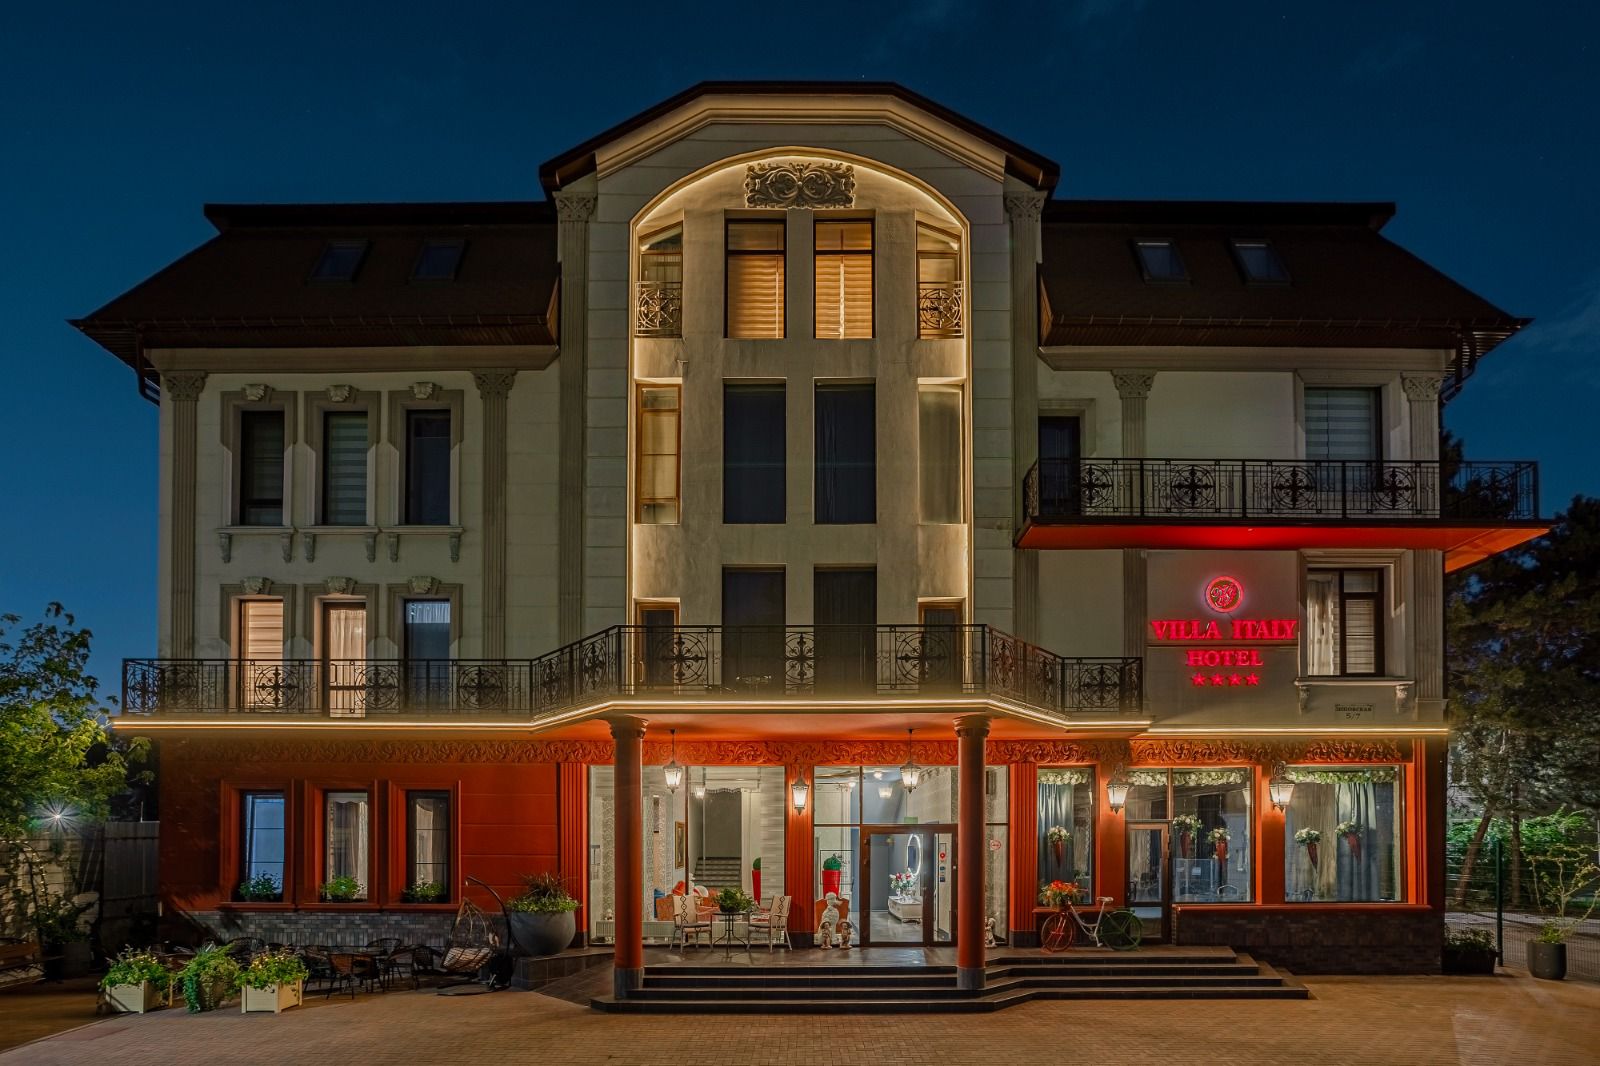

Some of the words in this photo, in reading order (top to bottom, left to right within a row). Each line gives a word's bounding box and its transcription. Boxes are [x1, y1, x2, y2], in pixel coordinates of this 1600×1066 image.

[1151, 619, 1221, 640] VILLA
[1232, 619, 1297, 640] ITALY
[1187, 650, 1264, 667] HOTEL
